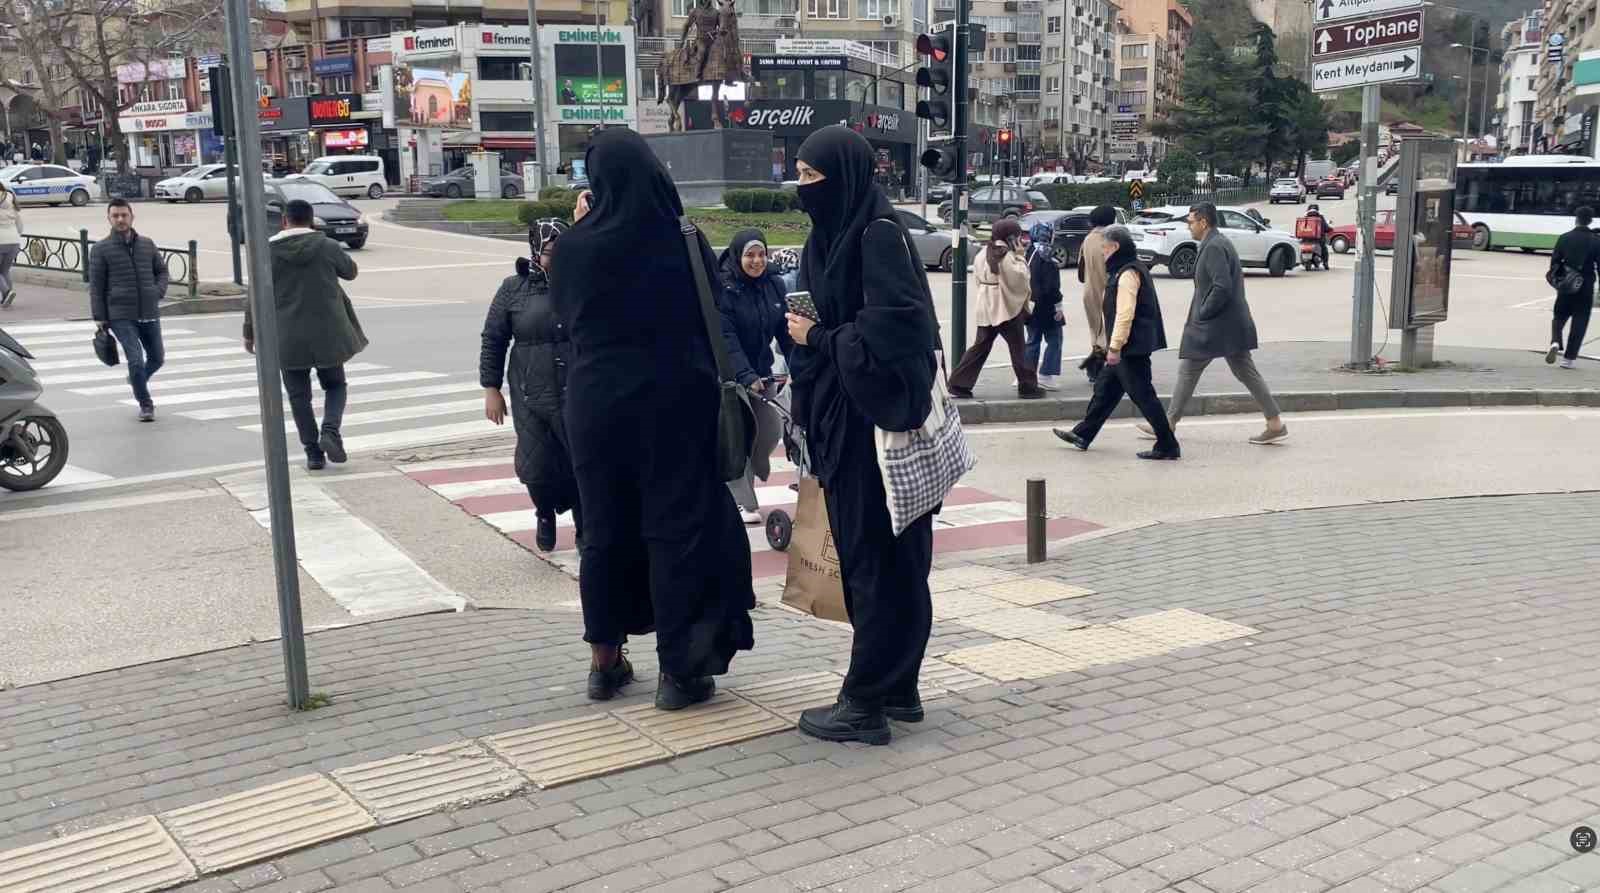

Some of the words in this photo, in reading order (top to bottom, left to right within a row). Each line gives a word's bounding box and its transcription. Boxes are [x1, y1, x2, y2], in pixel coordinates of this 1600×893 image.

[494, 32, 531, 45] femine
[559, 28, 621, 42] EMİNEVİM
[1343, 19, 1419, 45] Tophane
[415, 36, 454, 49] feminen
[1315, 67, 1342, 81] Kent
[1345, 61, 1393, 77] Meydanı
[562, 106, 624, 120] EMİNEVİM
[748, 106, 814, 129] arçelik
[145, 119, 167, 129] BOSCH
[801, 557, 825, 577] FRESH
